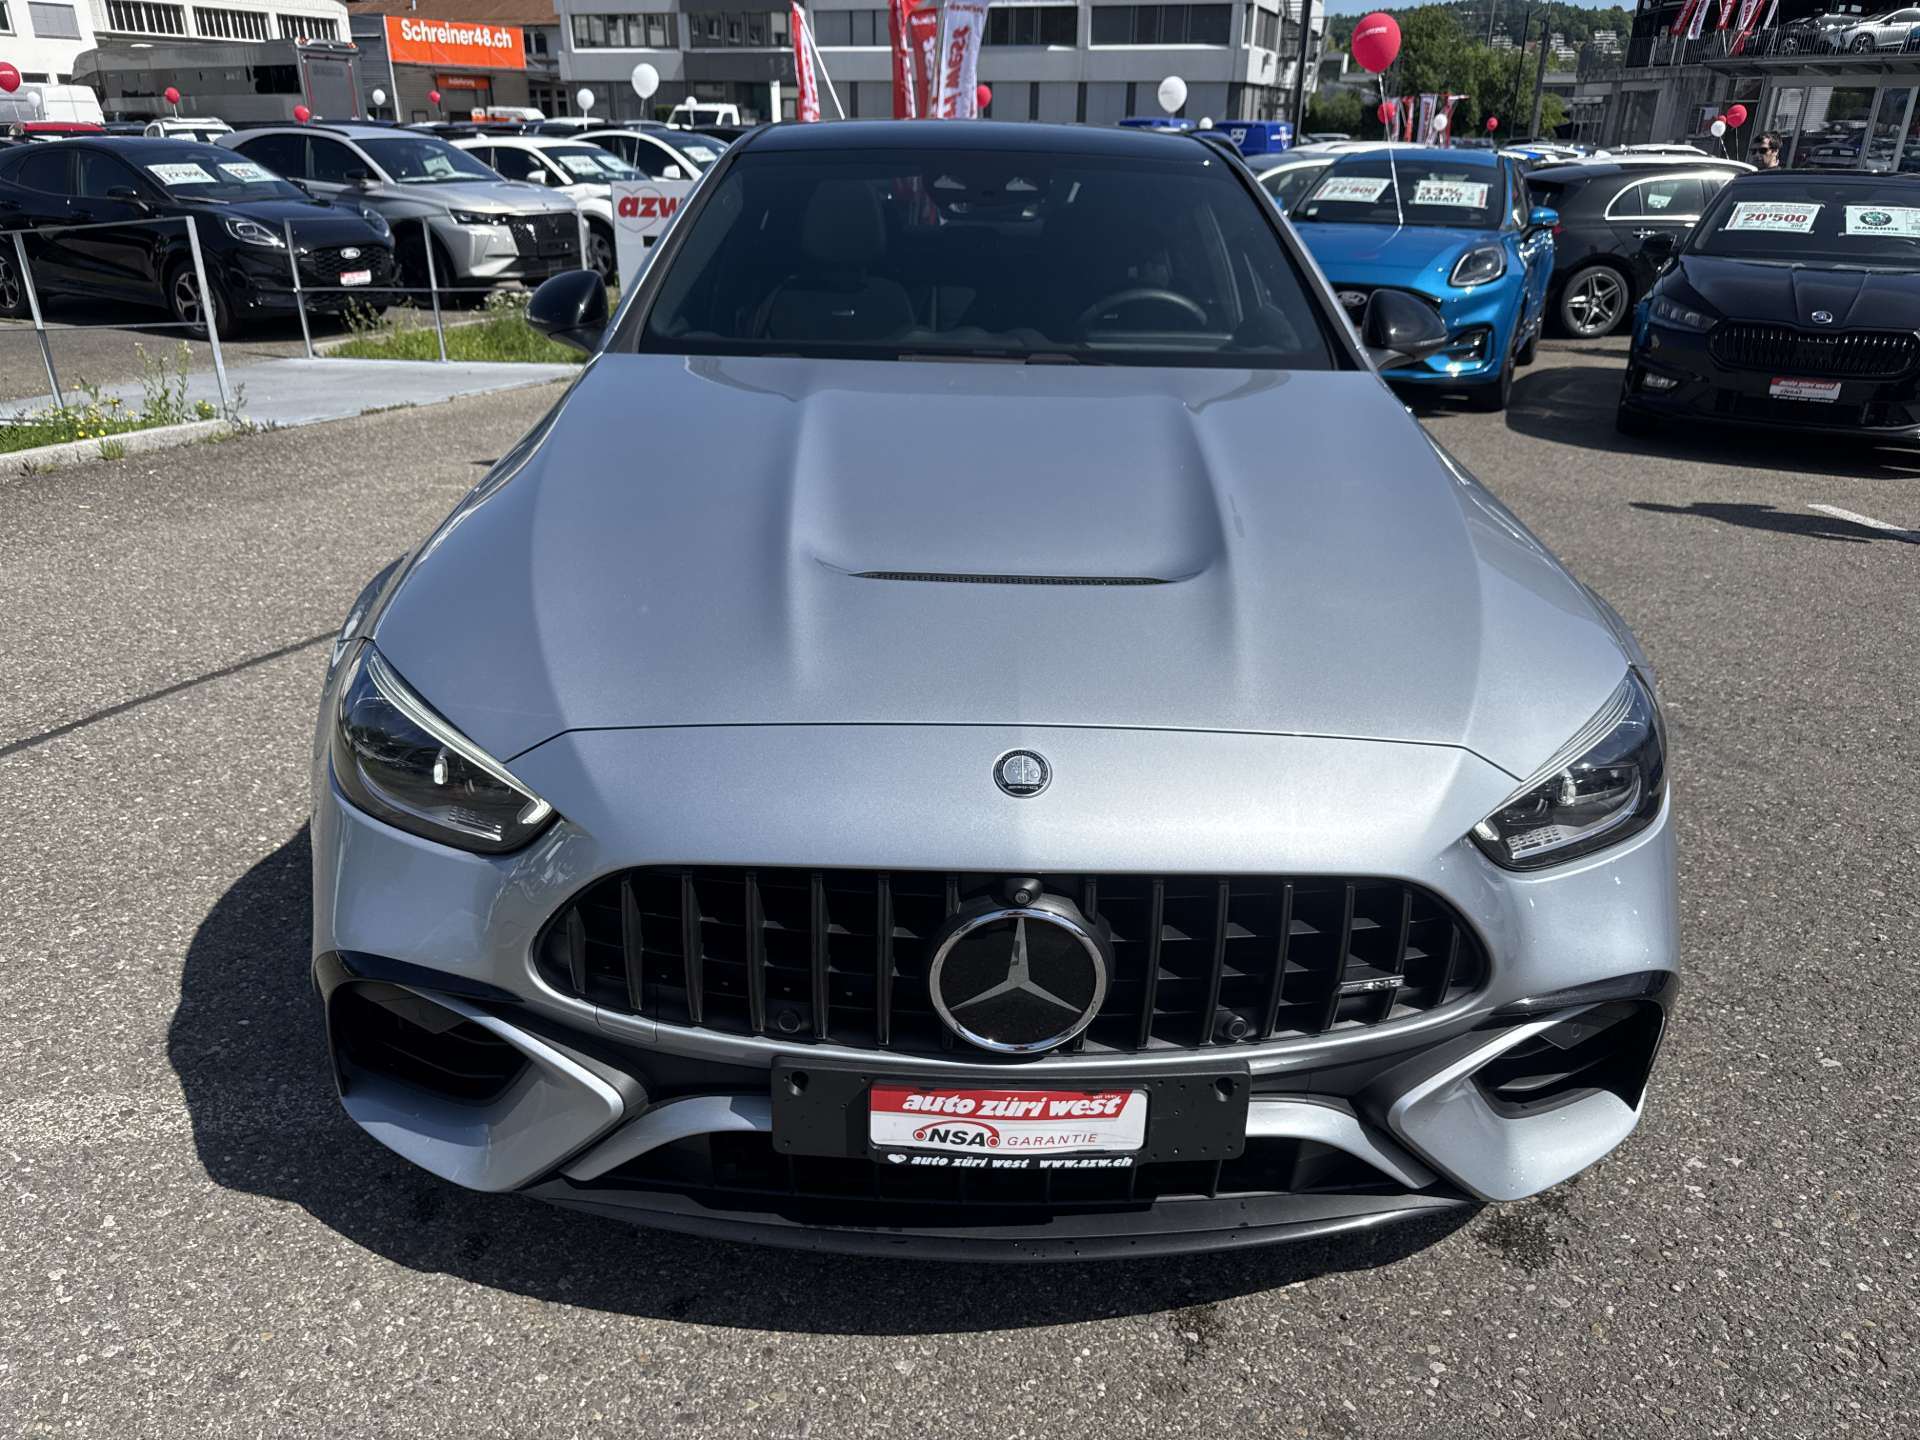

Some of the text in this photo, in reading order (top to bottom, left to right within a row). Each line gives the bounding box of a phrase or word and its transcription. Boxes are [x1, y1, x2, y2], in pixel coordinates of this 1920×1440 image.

[400, 18, 512, 48] Schreiner48.ch
[1421, 186, 1464, 198] 33%
[1743, 213, 1809, 223] 20'500
[902, 1094, 1122, 1117] auto züri west
[927, 1128, 986, 1147] NSA
[1007, 1133, 1098, 1147] GARANTIE
[910, 1155, 1134, 1168] auto züri west www.azw.ch
